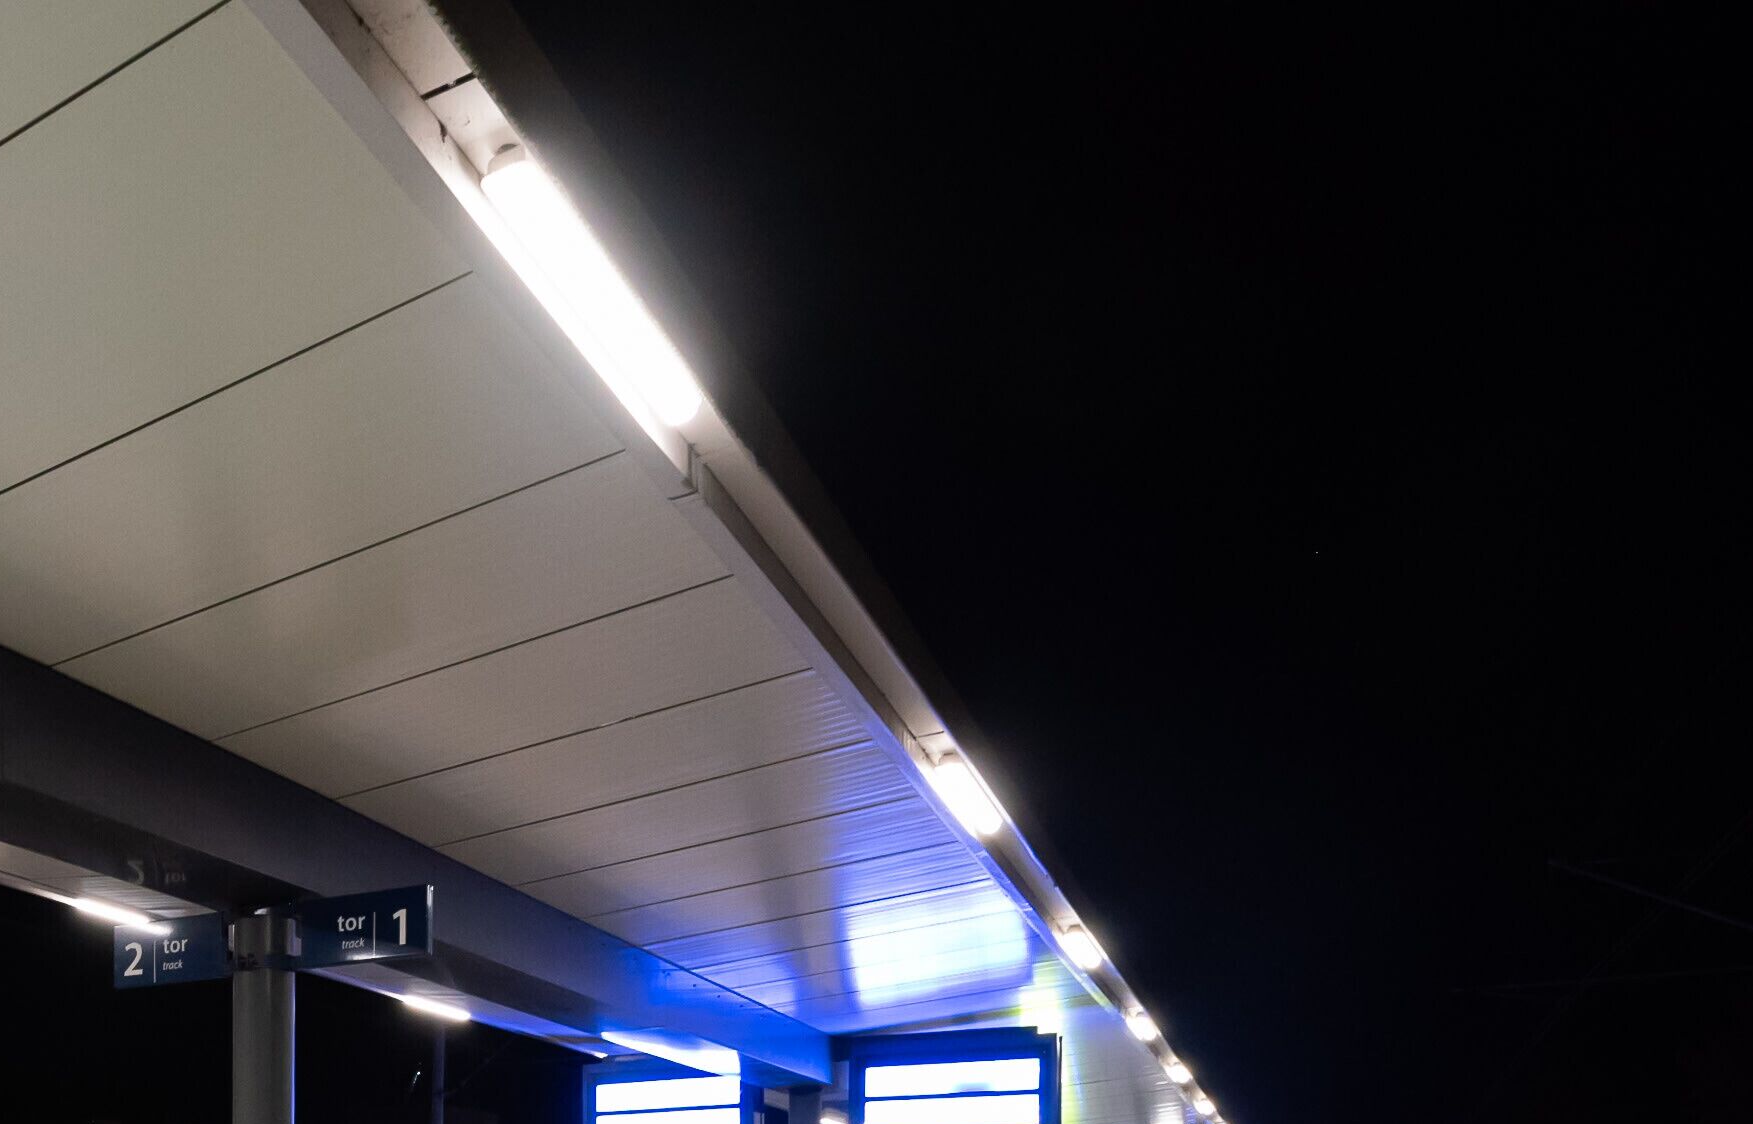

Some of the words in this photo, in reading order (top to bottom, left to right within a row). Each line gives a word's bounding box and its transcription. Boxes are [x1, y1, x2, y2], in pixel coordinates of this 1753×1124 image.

[337, 915, 366, 932] tor
[392, 908, 407, 946] 1
[341, 937, 366, 950] track
[123, 941, 144, 977] 2
[162, 938, 188, 954] tor
[162, 959, 183, 971] track
